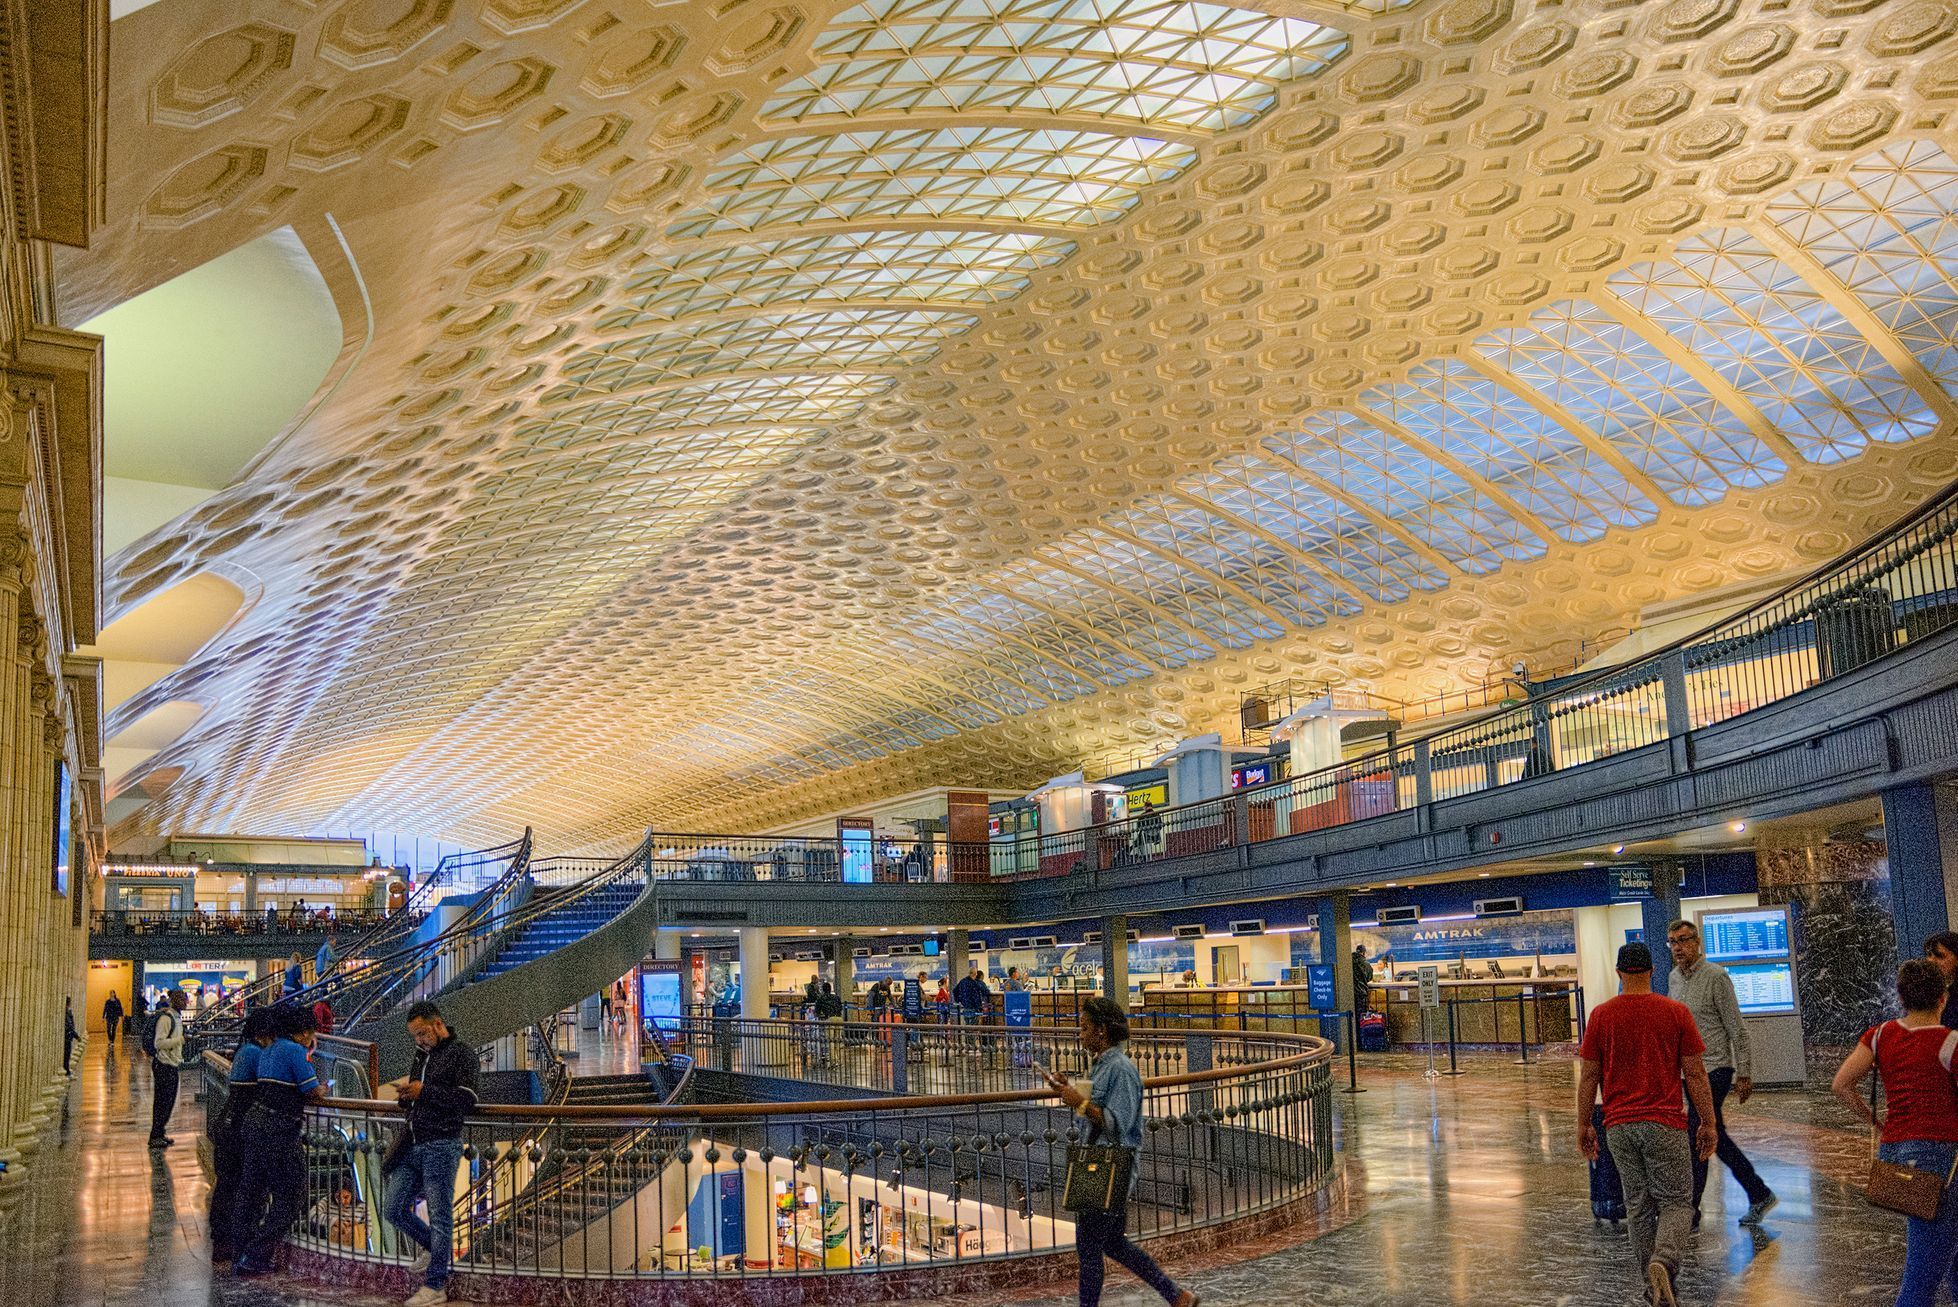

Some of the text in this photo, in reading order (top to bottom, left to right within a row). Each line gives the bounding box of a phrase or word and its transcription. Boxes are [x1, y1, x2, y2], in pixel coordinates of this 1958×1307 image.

[1246, 769, 1264, 779] Budget
[1129, 792, 1151, 805] Hertz
[842, 820, 872, 828] DIRECTORY
[166, 868, 189, 878] UNO
[1620, 870, 1649, 879] Self Serve
[1620, 879, 1649, 889] Ticketing
[1413, 928, 1483, 940] AMTRAK
[1072, 959, 1100, 977] acel
